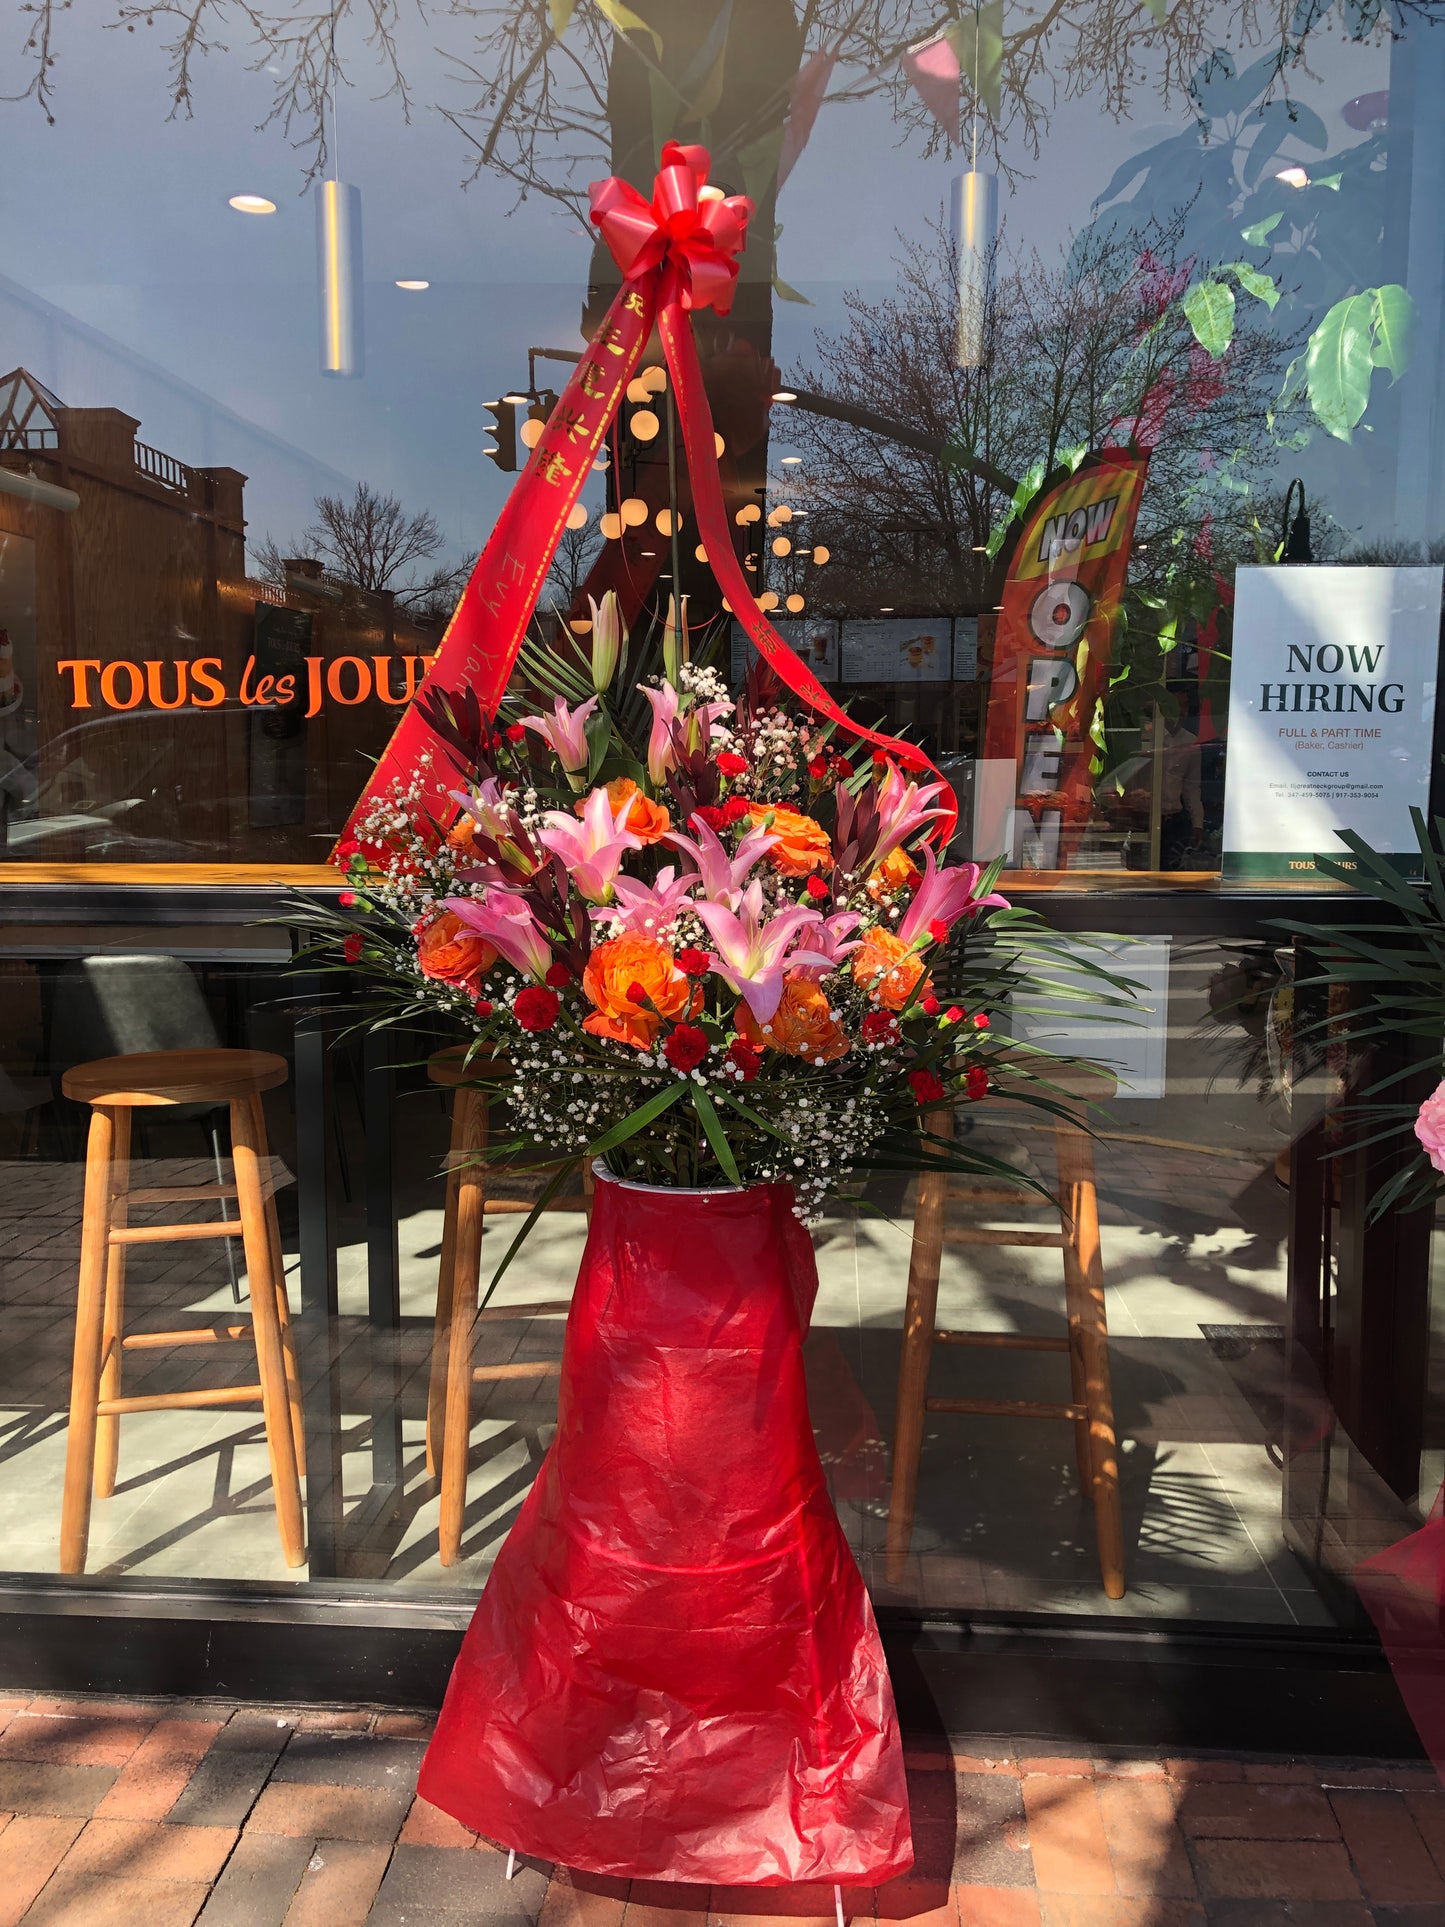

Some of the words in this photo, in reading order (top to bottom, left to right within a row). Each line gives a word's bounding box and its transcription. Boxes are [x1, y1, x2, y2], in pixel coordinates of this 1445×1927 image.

[1037, 495, 1119, 563] NOW
[1285, 643, 1386, 674] NOW
[57, 657, 227, 710] TOUS
[238, 654, 296, 706] les
[303, 655, 436, 719] JOU
[1258, 683, 1406, 713] HIRING
[1005, 580, 1092, 870] OPEN
[1278, 727, 1307, 738] FULL
[1310, 727, 1319, 738] &
[1321, 728, 1351, 738] PART
[1353, 728, 1382, 738] TIME
[1327, 741, 1364, 750] Cashier)
[1288, 860, 1316, 870] TOUS
